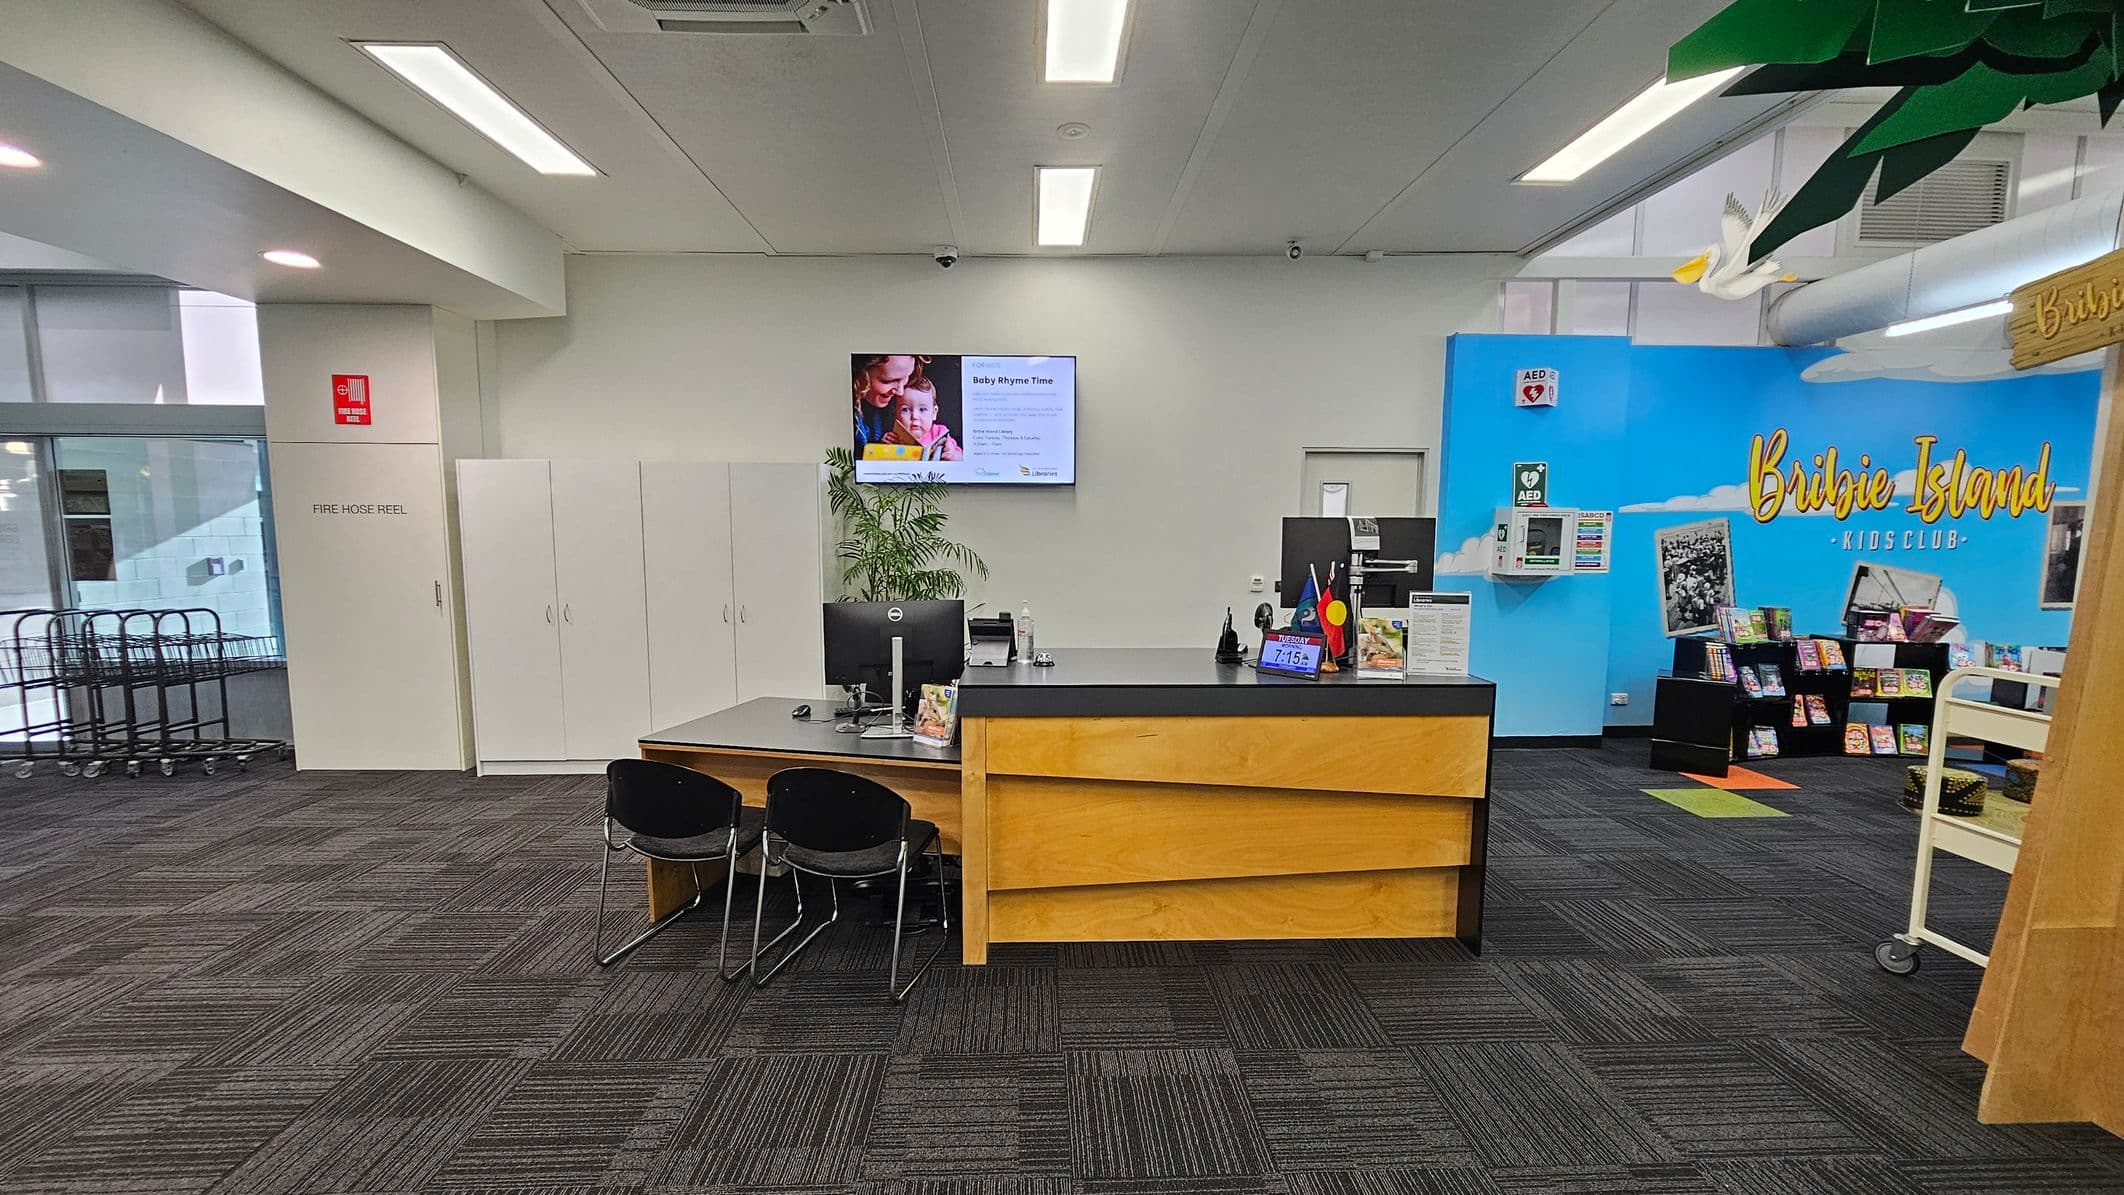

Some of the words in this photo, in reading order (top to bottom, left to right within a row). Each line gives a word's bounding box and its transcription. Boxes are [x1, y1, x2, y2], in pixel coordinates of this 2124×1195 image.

[2035, 277, 2124, 340] Bribi
[1523, 370, 1546, 380] AED
[972, 376, 996, 386] Baby
[998, 376, 1030, 387] Rhyme
[1031, 377, 1054, 385] Time
[1749, 428, 1896, 523] Bribie
[1906, 435, 2056, 524] Island
[1517, 490, 1542, 501] AED
[313, 504, 339, 514] FIRE
[341, 504, 375, 515] HOSE
[377, 504, 408, 515] REEL
[1843, 530, 1896, 551] KIDS
[1903, 529, 1959, 551] CLUB
[1278, 634, 1310, 645] TUESDAY
[1274, 649, 1302, 665] 7:15
